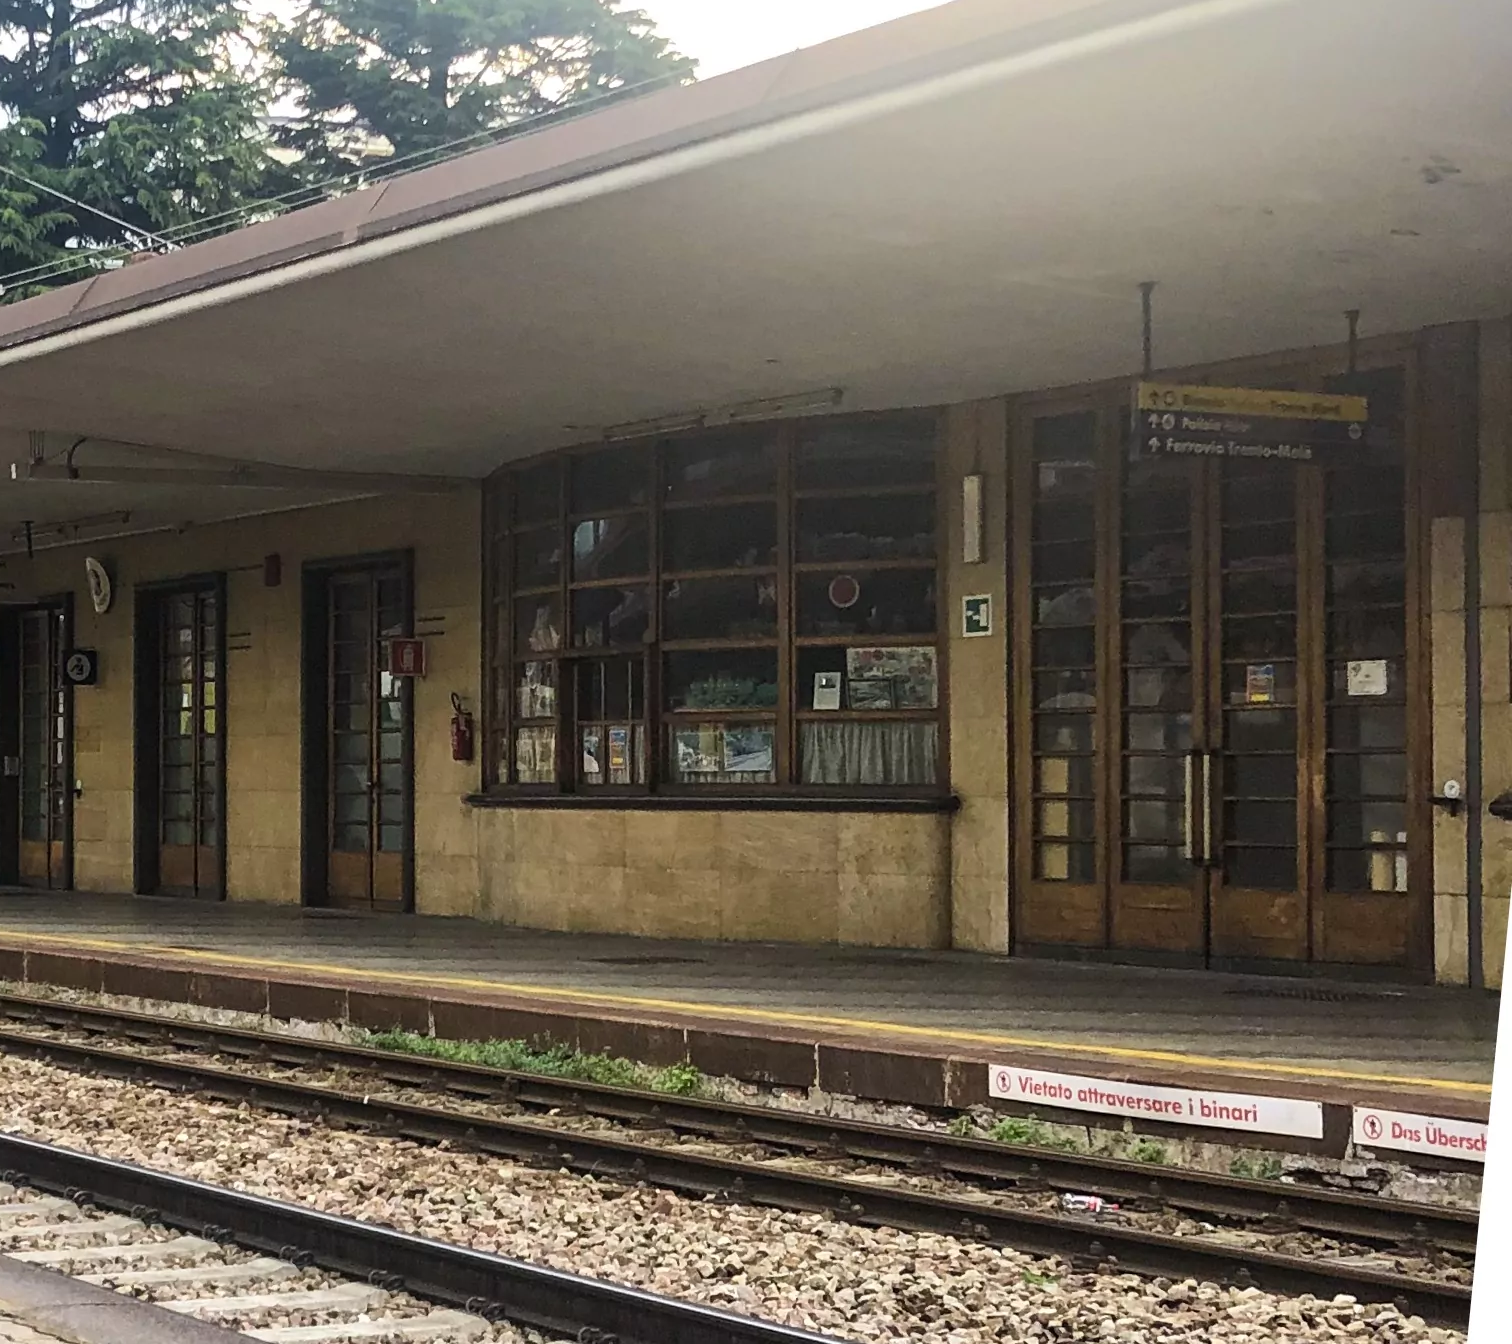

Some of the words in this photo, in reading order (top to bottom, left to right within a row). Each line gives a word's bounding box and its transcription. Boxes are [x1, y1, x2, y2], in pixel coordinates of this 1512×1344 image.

[1018, 1075, 1073, 1102] Vietato
[1077, 1086, 1183, 1115] attraversare
[1188, 1097, 1194, 1116] i
[1199, 1097, 1258, 1123] binari
[1391, 1120, 1422, 1143] Das
